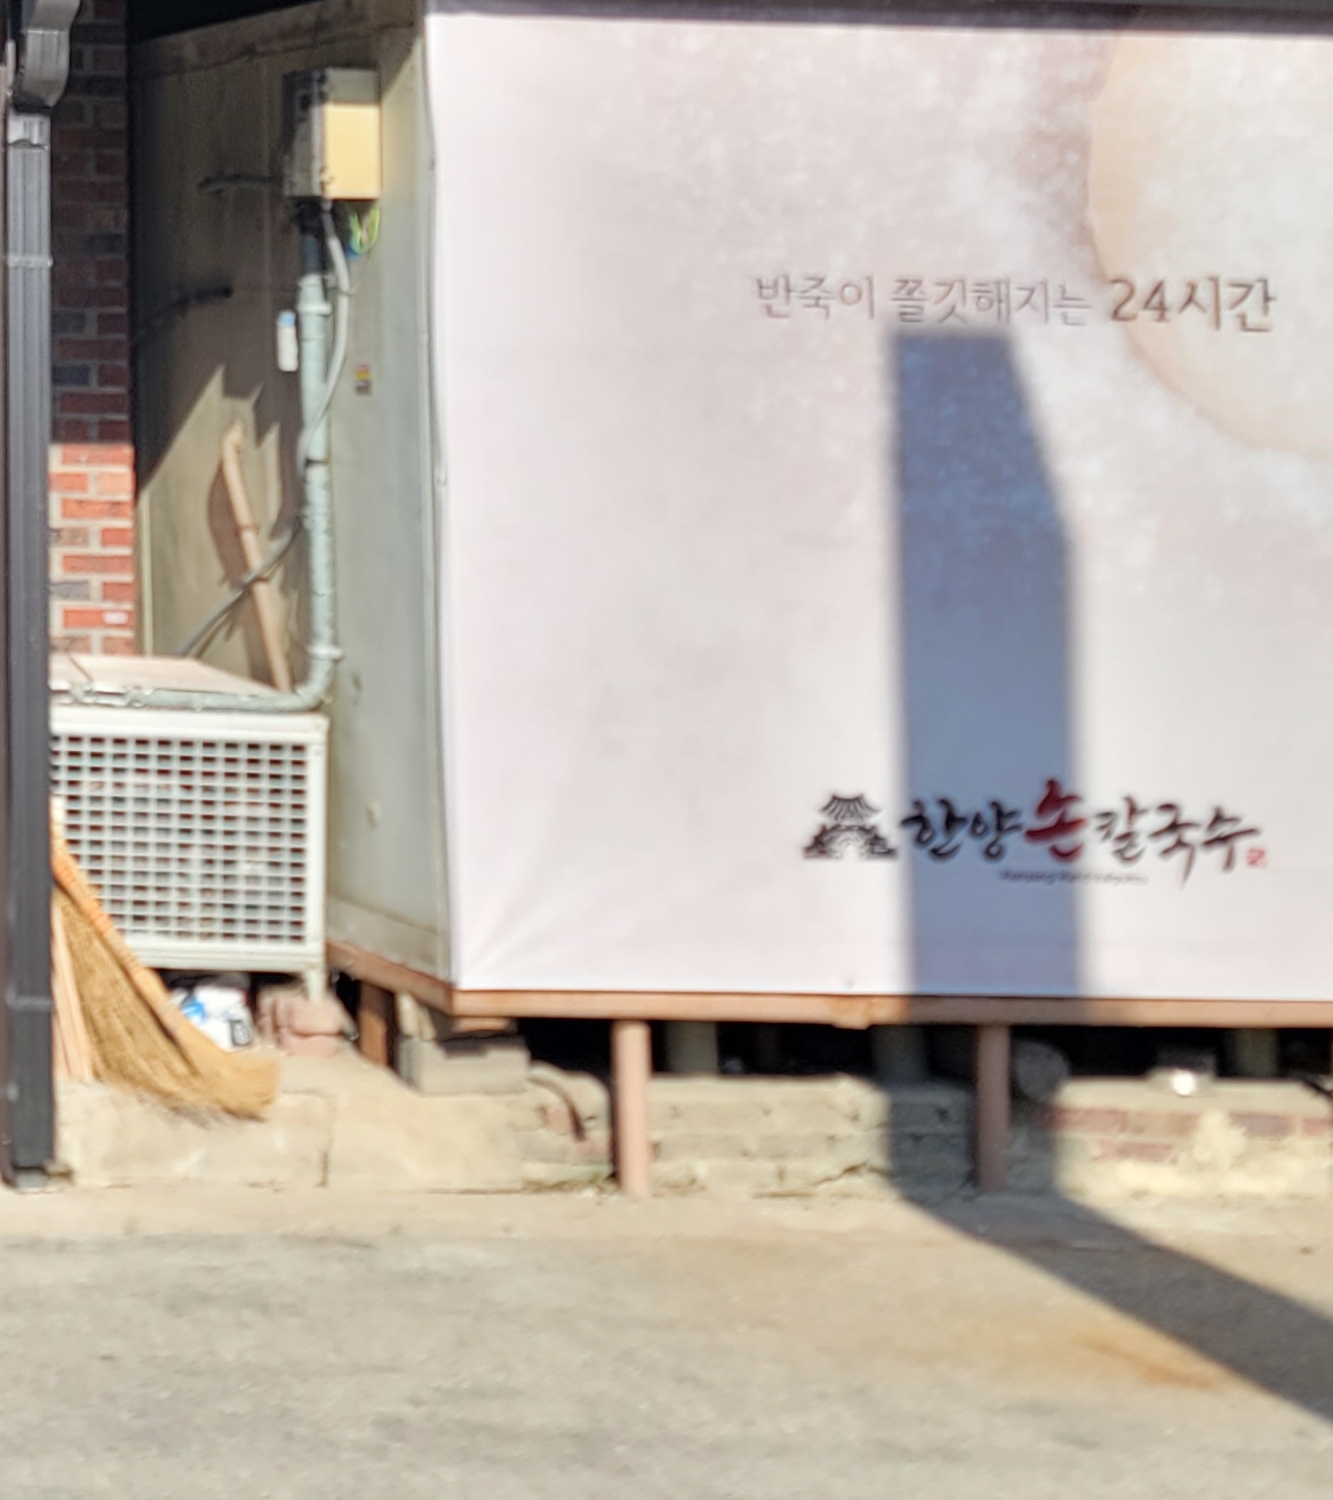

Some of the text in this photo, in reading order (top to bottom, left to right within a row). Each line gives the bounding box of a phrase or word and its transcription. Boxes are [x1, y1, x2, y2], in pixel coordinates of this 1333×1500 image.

[755, 274, 1278, 334] 반죽이 쫄깃해지는 24시간
